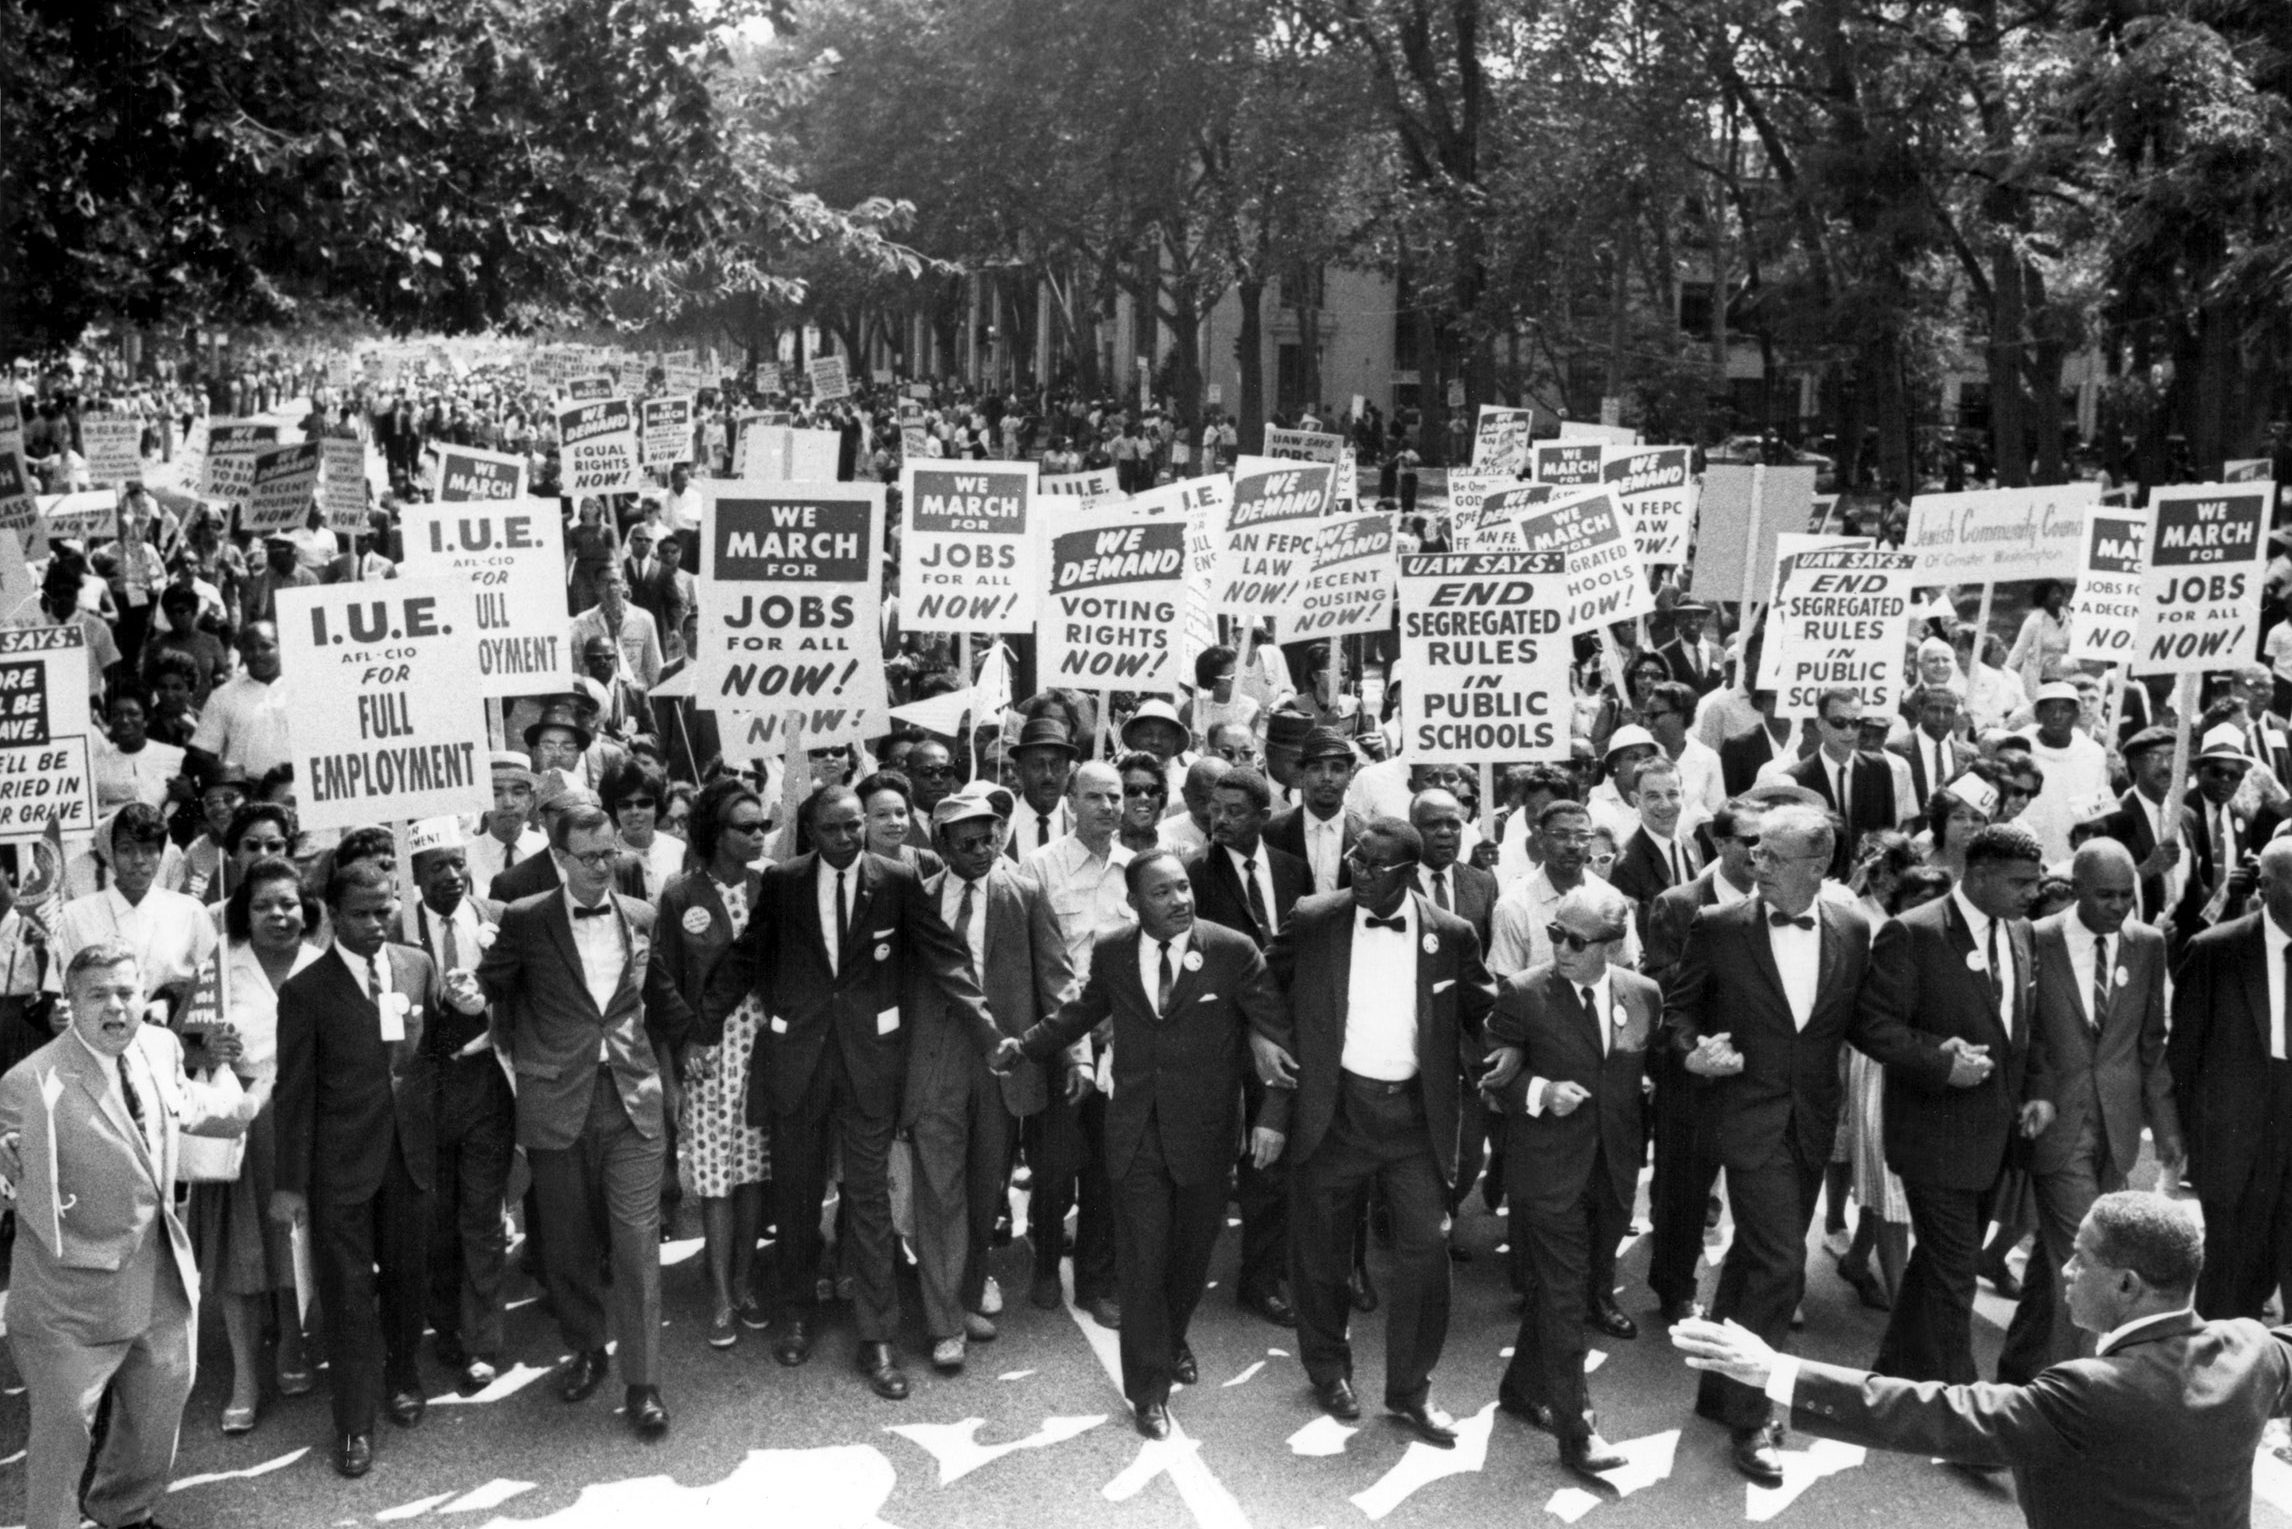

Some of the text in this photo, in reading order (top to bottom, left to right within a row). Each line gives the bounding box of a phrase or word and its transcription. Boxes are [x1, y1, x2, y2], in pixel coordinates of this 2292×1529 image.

[581, 404, 607, 422] WE
[565, 414, 628, 442] DEMAND
[574, 445, 625, 458] EQUAL
[1273, 434, 1334, 449] UAW SAYS
[574, 458, 629, 471] RIGHTS
[1562, 448, 1582, 460] WE
[1629, 453, 1660, 475] WE
[474, 461, 497, 478] WE
[1542, 460, 1599, 476] MARCH
[450, 473, 513, 498] MARCH
[575, 471, 631, 488] NOW!
[955, 476, 989, 494] WE
[1263, 471, 1303, 496] WE
[1559, 476, 1582, 484] FOR
[1618, 465, 1683, 495] EMAND
[921, 495, 1019, 518] MARCH
[1233, 489, 1322, 525] DEMAND
[1503, 489, 1533, 508] WE
[1642, 501, 1682, 515] FEPC
[771, 506, 817, 527] WE
[1552, 506, 1582, 526] WE
[2197, 502, 2228, 520] WE
[429, 516, 544, 552] I.U.E.
[950, 519, 990, 531] FOR
[1318, 521, 1360, 548] WE
[1534, 512, 1613, 554] MARCH
[1635, 520, 1668, 533] AW
[1911, 509, 1955, 547] Jewish
[1960, 505, 2037, 549] Community
[2129, 523, 2147, 540] W
[2162, 521, 2254, 548] MARCH
[726, 531, 858, 559] MARCH
[1095, 527, 1146, 556] WE
[1229, 533, 1260, 552] AN
[1477, 531, 1498, 544] AN
[1634, 535, 1680, 554] OW!
[453, 556, 515, 567] AFL-CIO
[919, 542, 1017, 570] JOBS
[1407, 553, 1563, 575] UAW SAYS:
[1568, 544, 1628, 575] GRATED
[1799, 553, 1914, 569] UAW SAYS:
[2189, 548, 2224, 562] FOR
[471, 570, 509, 586] FOR
[766, 564, 818, 577] FOR
[1058, 548, 1181, 587] DEMAND
[1242, 559, 1292, 577] LAW
[921, 573, 1012, 586] FOR ALL
[1306, 569, 1382, 590] ECENT
[1810, 575, 1888, 593] END
[2085, 580, 2122, 595] JOBS
[2156, 573, 2247, 605] JOBS
[1223, 580, 1300, 604] NOW!
[1303, 588, 1387, 610] OUSING
[1428, 581, 1534, 607] END
[475, 592, 510, 629] ULL
[723, 595, 854, 629] JOBS
[917, 593, 1019, 620] NOW!
[1061, 597, 1176, 623] VOTING
[1790, 597, 1905, 618] SEGREGATED
[2081, 602, 2140, 618] A DECEN
[2157, 607, 2240, 624] FOR ALL
[310, 596, 453, 646] I.U.E.
[1294, 603, 1382, 634] NOW!
[1406, 609, 1561, 638] SEGREGATED
[1066, 624, 1168, 650] RIGHTS
[1804, 621, 1884, 640] RULES
[2086, 627, 2136, 650] NO
[727, 637, 849, 650] FOR ALL
[1428, 638, 1538, 665] RULES
[1826, 648, 1856, 659] IN
[2149, 625, 2246, 661] NOW!
[341, 646, 417, 664] AFL-CIO
[477, 635, 558, 675] OYMENT
[1061, 651, 1169, 679] NOW!
[361, 664, 410, 684] FOR
[721, 658, 859, 696] NOW!
[1462, 675, 1503, 689] IN
[1796, 662, 1887, 682] PUBLIC
[12, 693, 42, 715] BE
[357, 690, 414, 739] FULL
[1424, 691, 1549, 719] PUBLIC
[1418, 722, 1554, 751] SCHOOLS
[37, 750, 68, 772] BE
[309, 741, 475, 801] EMPLOYMENT
[56, 776, 80, 796] IN
